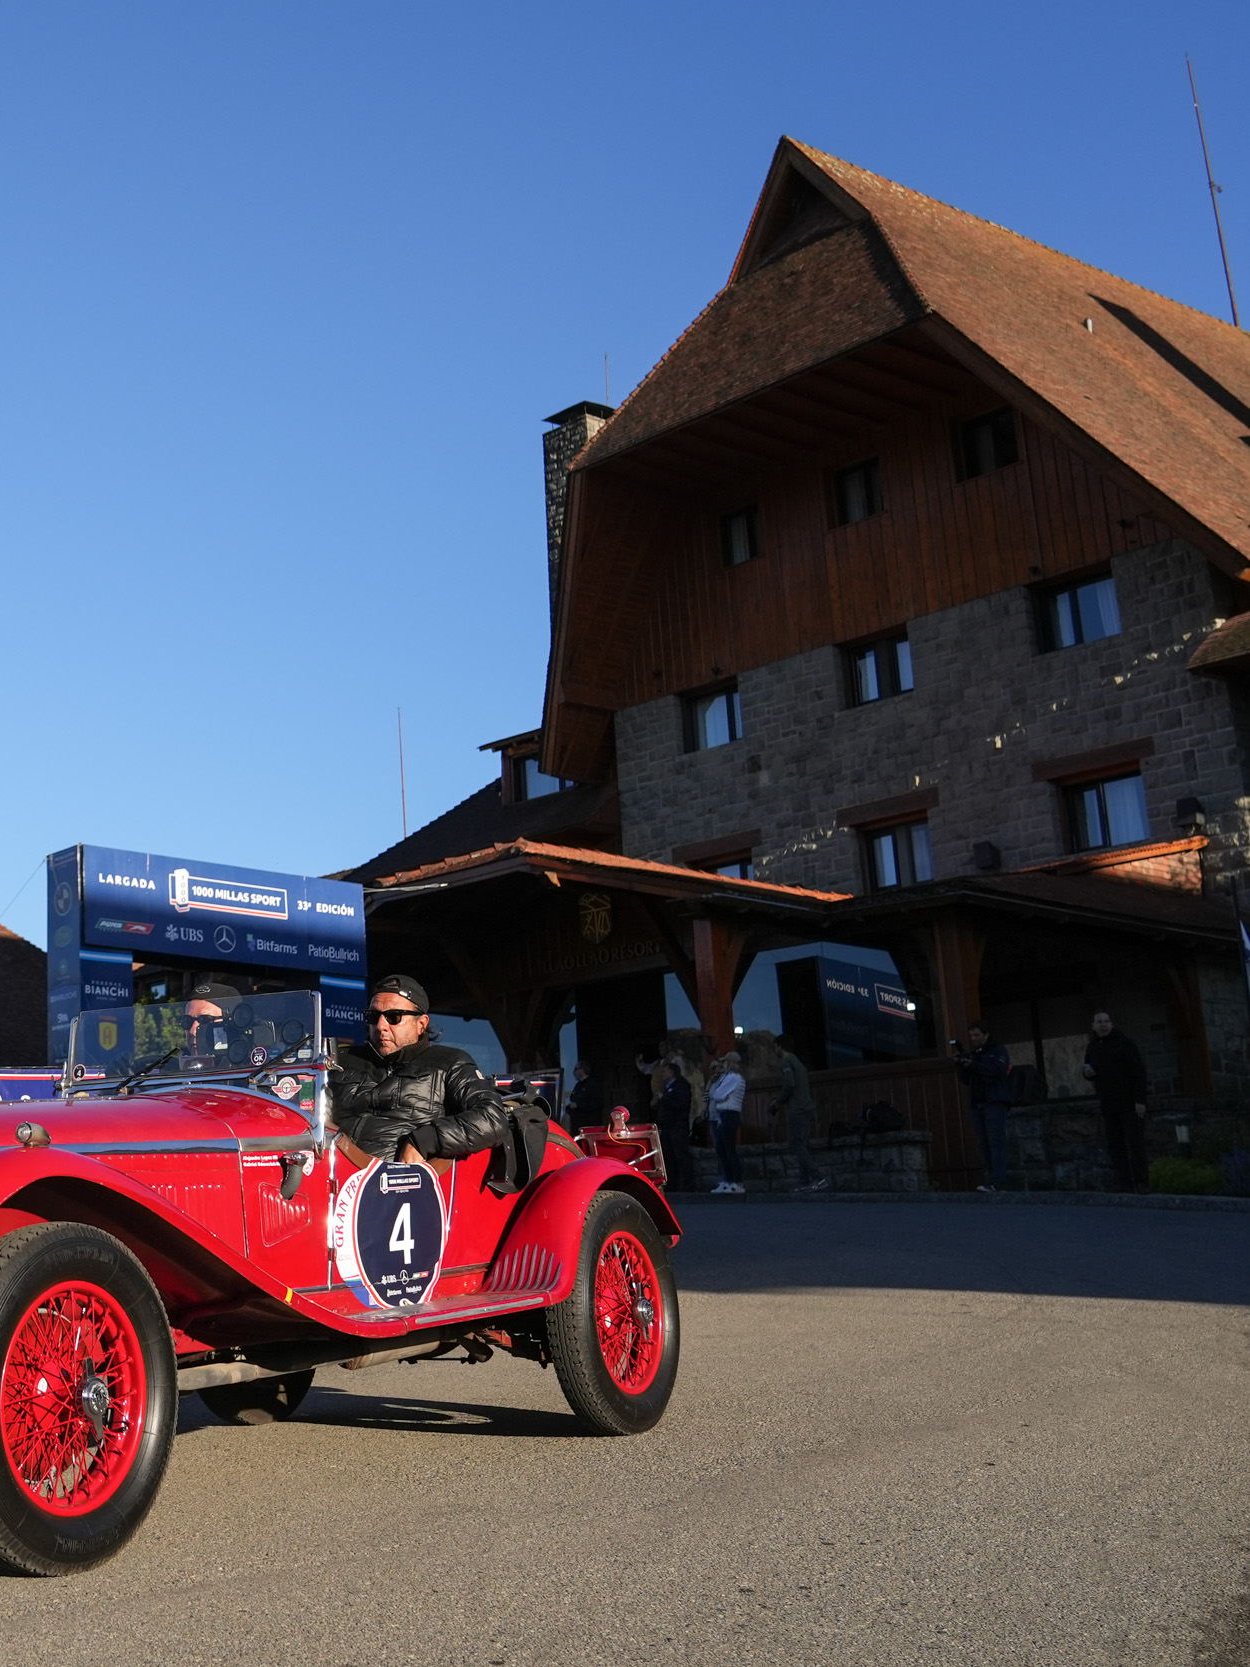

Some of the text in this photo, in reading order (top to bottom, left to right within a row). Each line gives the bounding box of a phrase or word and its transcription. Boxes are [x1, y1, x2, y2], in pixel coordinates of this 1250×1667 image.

[98, 872, 156, 890] LARGADA
[191, 885, 282, 907] 1000 MILLAS SPORT
[316, 902, 355, 917] EDICIÓN
[99, 920, 124, 929] PUMA
[180, 926, 204, 943] UBS
[256, 938, 298, 955] Bitfarms
[308, 943, 360, 962] PatioBullrich
[84, 984, 129, 998] BIANCHI
[325, 1008, 364, 1022] BIANCHI
[76, 1069, 82, 1077] 4
[334, 1199, 349, 1248] GRAN
[388, 1202, 415, 1265] 4
